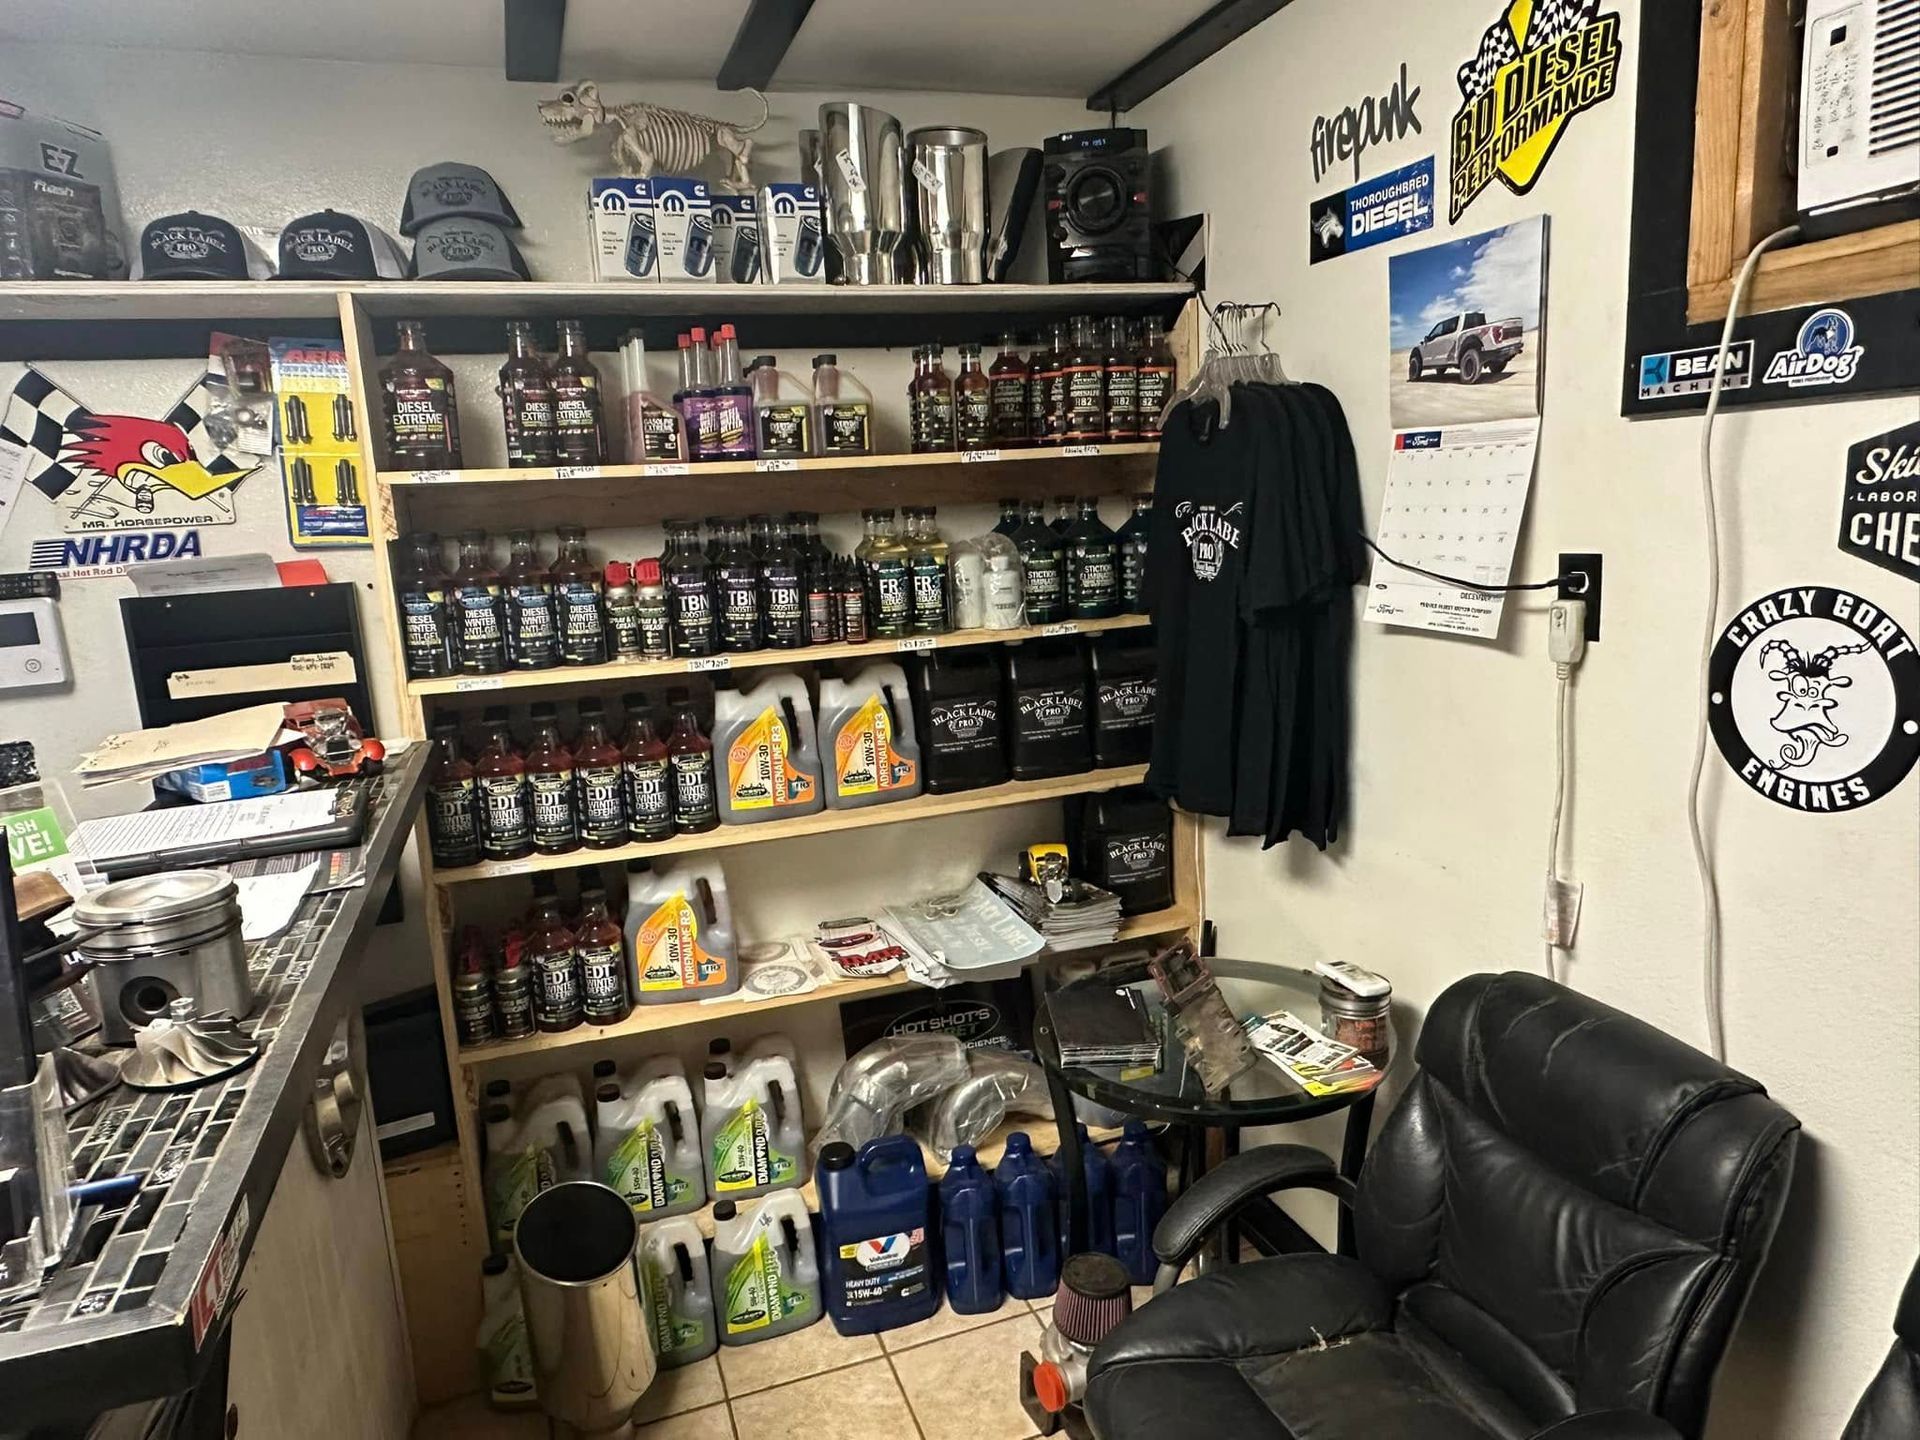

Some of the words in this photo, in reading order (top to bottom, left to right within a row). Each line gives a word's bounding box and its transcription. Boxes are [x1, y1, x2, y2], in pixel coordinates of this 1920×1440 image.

[1453, 87, 1497, 172] BD
[1502, 20, 1619, 128] DIESEL
[1452, 63, 1613, 220] PERFORMANCE
[1350, 173, 1430, 212] THOROUGHBRED
[1351, 193, 1430, 237] DIESEL
[1675, 350, 1743, 377] BEAN
[1770, 352, 1850, 378] AirDog
[1641, 377, 1750, 398] MACHINE
[397, 401, 435, 414] DIESEL
[558, 400, 587, 410] DIESEL
[393, 413, 443, 425] EXTREME
[556, 410, 593, 420] EXTREME
[1855, 444, 1920, 486] Ski
[1857, 491, 1918, 502] LABOR
[82, 520, 110, 529] MR.
[114, 516, 213, 528] HORSEPOWER
[1208, 513, 1241, 550] LABE
[1849, 512, 1920, 566] CHE
[61, 530, 202, 567] NHRDA
[92, 568, 114, 576] Rod
[678, 595, 710, 611] TBN
[728, 590, 756, 606] TBN
[770, 588, 800, 604] TBN
[464, 608, 494, 618] DIESEL
[522, 607, 549, 616] DIESEL
[568, 613, 598, 622] WINTER
[570, 604, 598, 614] DIESEL
[464, 618, 496, 627] WINTER
[520, 616, 550, 625] WINTER
[1727, 590, 1816, 648] CRAZY
[1832, 594, 1914, 660] GOAT
[1100, 686, 1132, 703] BLACK
[1135, 686, 1156, 696] LABE
[1020, 696, 1054, 714] BLACK
[1056, 696, 1083, 710] LABEL
[1046, 707, 1060, 716] PRO
[932, 708, 966, 726] BLACK
[968, 706, 997, 721] LABEL
[958, 718, 974, 728] PRO
[864, 732, 875, 767] 10W-30
[877, 729, 890, 787] ADRENALINE
[758, 744, 770, 780] 10W-30
[772, 742, 786, 803] ADRENALINE
[1741, 757, 1871, 811] ENGINES
[7, 819, 38, 836] ASH
[1110, 842, 1140, 858] BLACK
[1142, 841, 1166, 852] LABEL
[1132, 852, 1147, 860] PRO
[668, 928, 680, 964] 10W-30
[681, 925, 695, 984] ADRENALINE
[892, 1018, 930, 1038] HOT
[930, 1008, 991, 1030] SHOT'S
[959, 1036, 1006, 1050] SCIENCE
[846, 1280, 864, 1288] HEAVY
[865, 1276, 880, 1286] DUTY
[854, 1286, 882, 1300] 15W-40
